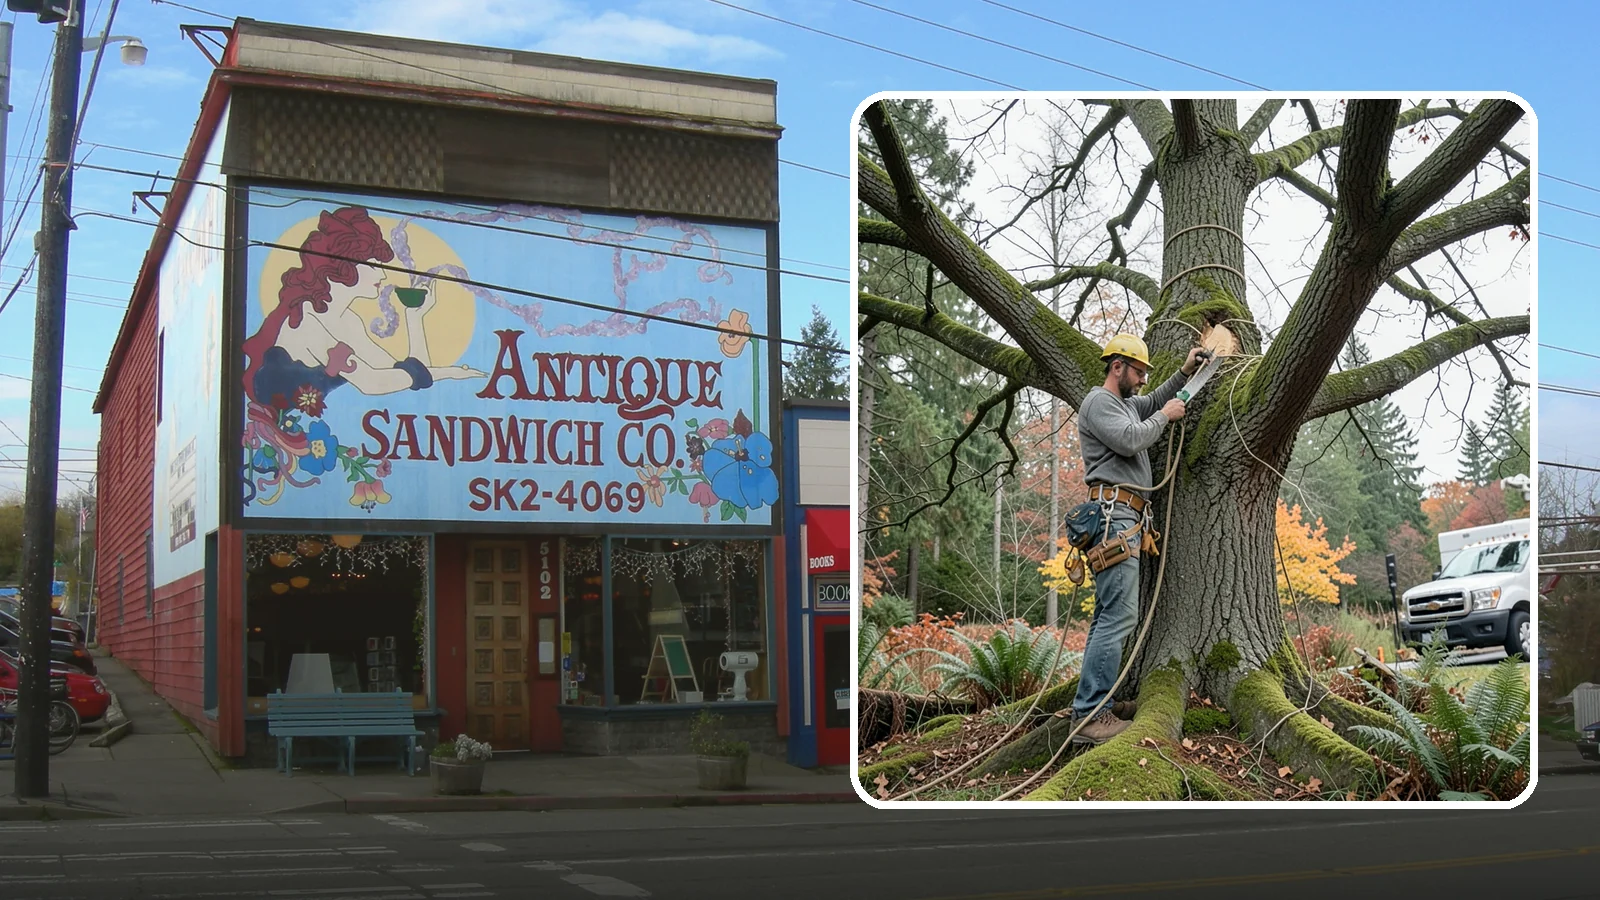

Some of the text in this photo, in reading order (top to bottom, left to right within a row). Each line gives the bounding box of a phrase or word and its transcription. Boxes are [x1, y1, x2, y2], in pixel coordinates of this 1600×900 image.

[476, 329, 723, 421] ANTIQUE
[361, 408, 686, 469] SANDWICH CO.
[468, 477, 646, 513] SK2-4069
[540, 541, 551, 600] 5102
[809, 555, 834, 568] BOOKS
